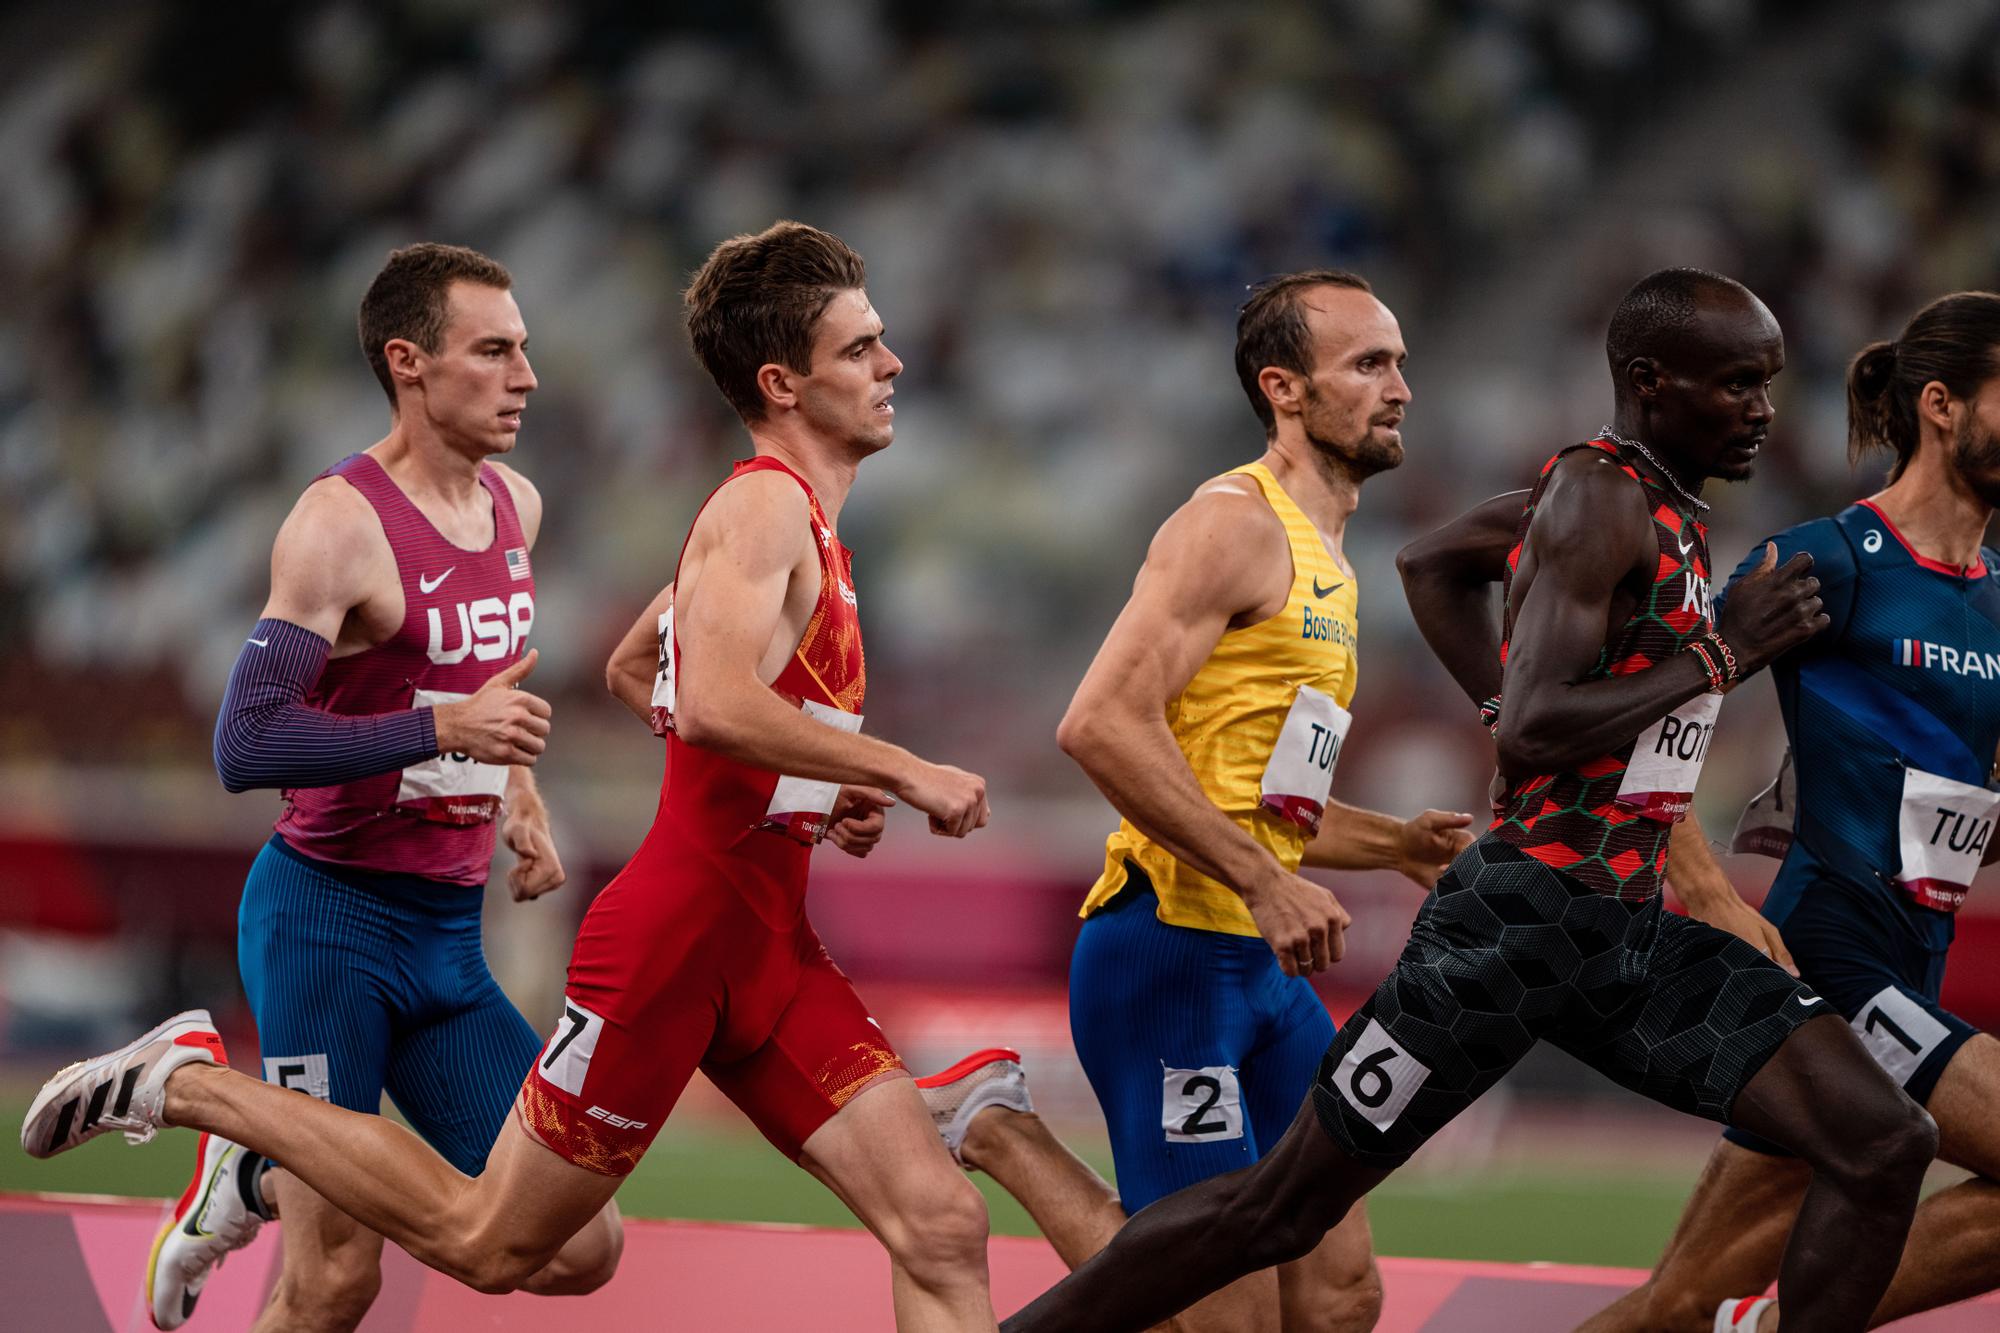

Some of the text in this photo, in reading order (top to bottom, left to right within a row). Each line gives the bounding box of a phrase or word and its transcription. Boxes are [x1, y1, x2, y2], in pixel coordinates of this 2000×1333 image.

[426, 592, 535, 665] USA
[1924, 642, 2000, 680] FRAN
[1930, 808, 1991, 856] TUA
[543, 1005, 589, 1070] 7
[1865, 1005, 1923, 1056] 1
[1351, 1047, 1399, 1108] 6
[585, 1105, 648, 1130] ESP
[1182, 1076, 1227, 1134] 2
